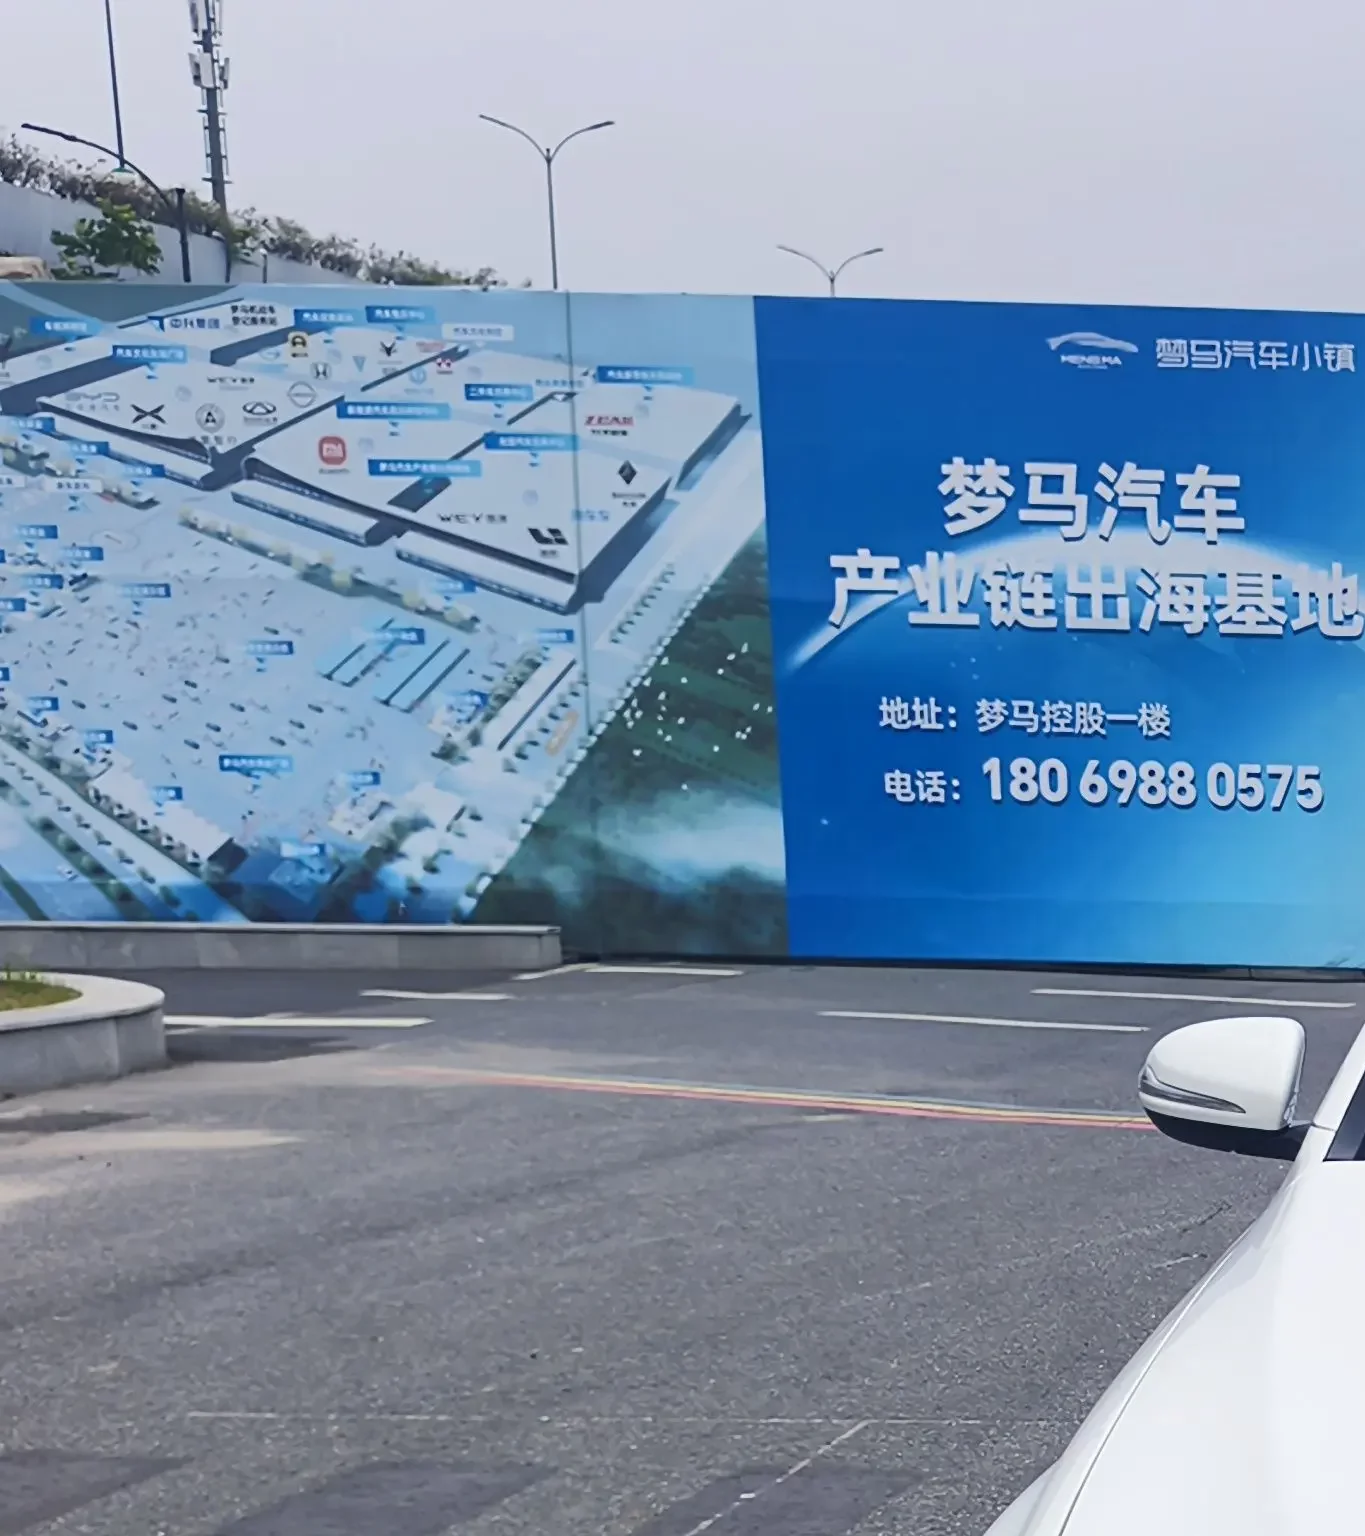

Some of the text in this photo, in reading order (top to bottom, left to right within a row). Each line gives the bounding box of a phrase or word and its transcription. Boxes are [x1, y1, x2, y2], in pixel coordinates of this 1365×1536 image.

[1156, 337, 1356, 373] 梦马汽车小镇
[936, 456, 1246, 544] 梦马汽车
[981, 756, 1068, 804] 180
[1079, 759, 1198, 807] 6988
[1206, 764, 1325, 811] 0575
